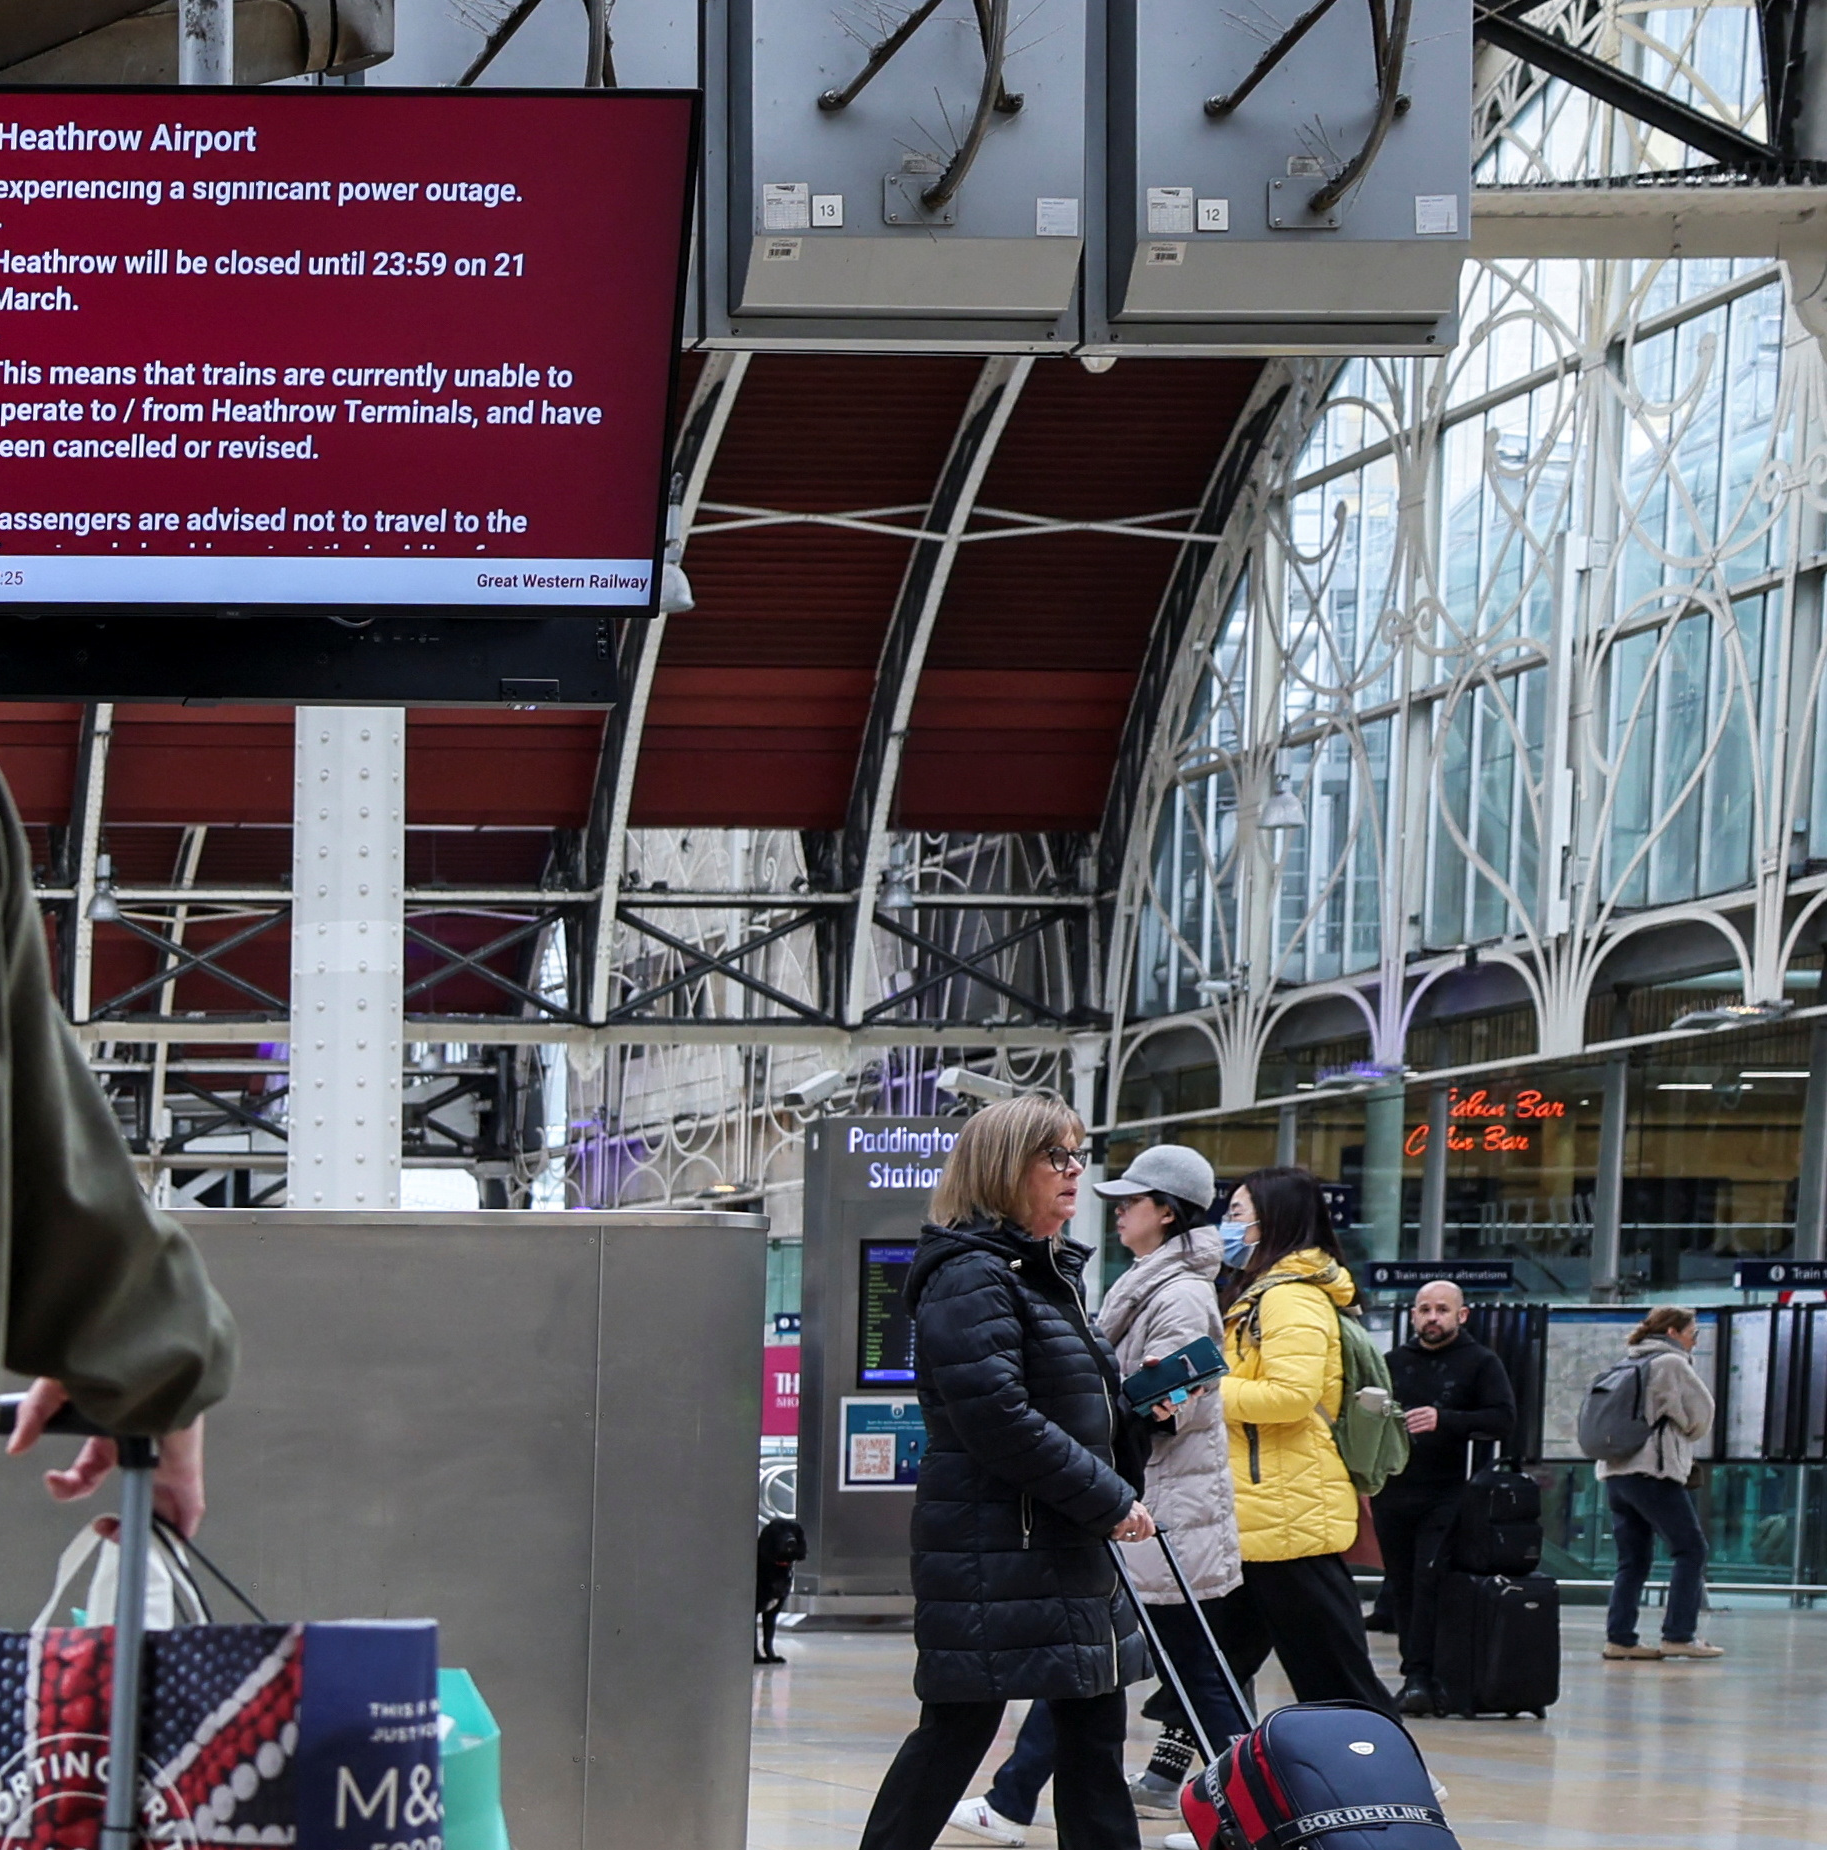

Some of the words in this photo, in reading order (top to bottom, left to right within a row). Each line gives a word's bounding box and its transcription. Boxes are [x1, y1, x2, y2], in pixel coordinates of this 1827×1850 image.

[149, 122, 257, 159] Airport
[169, 180, 185, 200] a
[192, 180, 332, 206] significant
[337, 182, 420, 207] power
[425, 181, 523, 209] outage.
[820, 204, 835, 217] 13
[1205, 208, 1221, 222] 12
[124, 248, 169, 275] will
[175, 248, 208, 275] be
[214, 249, 301, 275] closed
[308, 250, 366, 276] until
[372, 251, 447, 277] 23:59
[454, 257, 487, 277] on
[493, 252, 524, 277] 21
[49, 365, 137, 385] means
[143, 359, 196, 386] that
[201, 361, 277, 386] trains
[283, 367, 326, 387] are
[331, 361, 448, 394] currently
[454, 362, 541, 388] unable
[546, 365, 573, 388] to
[90, 399, 117, 422] to
[122, 397, 136, 424] /
[141, 396, 204, 422] from
[211, 397, 337, 423] Heathrow
[343, 398, 479, 429] Terminals,
[485, 399, 535, 425] and
[540, 399, 602, 425] have
[52, 433, 178, 459] cancelled
[183, 440, 212, 459] or
[217, 434, 319, 460] revised.
[138, 512, 180, 531] are
[186, 506, 287, 532] advised
[293, 509, 336, 532] not
[341, 510, 368, 532] to
[374, 507, 447, 533] travel
[453, 510, 480, 533] to
[486, 508, 528, 534] the
[476, 573, 519, 588] Great
[522, 573, 585, 589] Western
[588, 573, 649, 593] Railway
[1514, 1089, 1566, 1119] Bar
[848, 1126, 960, 1159] Paddingto
[1482, 1124, 1530, 1151] Bar
[1393, 1269, 1418, 1280] Train
[1455, 1269, 1508, 1280] alterations
[1791, 1266, 1821, 1280] Train
[335, 1763, 445, 1831] M&
[1297, 1806, 1433, 1835] BORDERLINE
